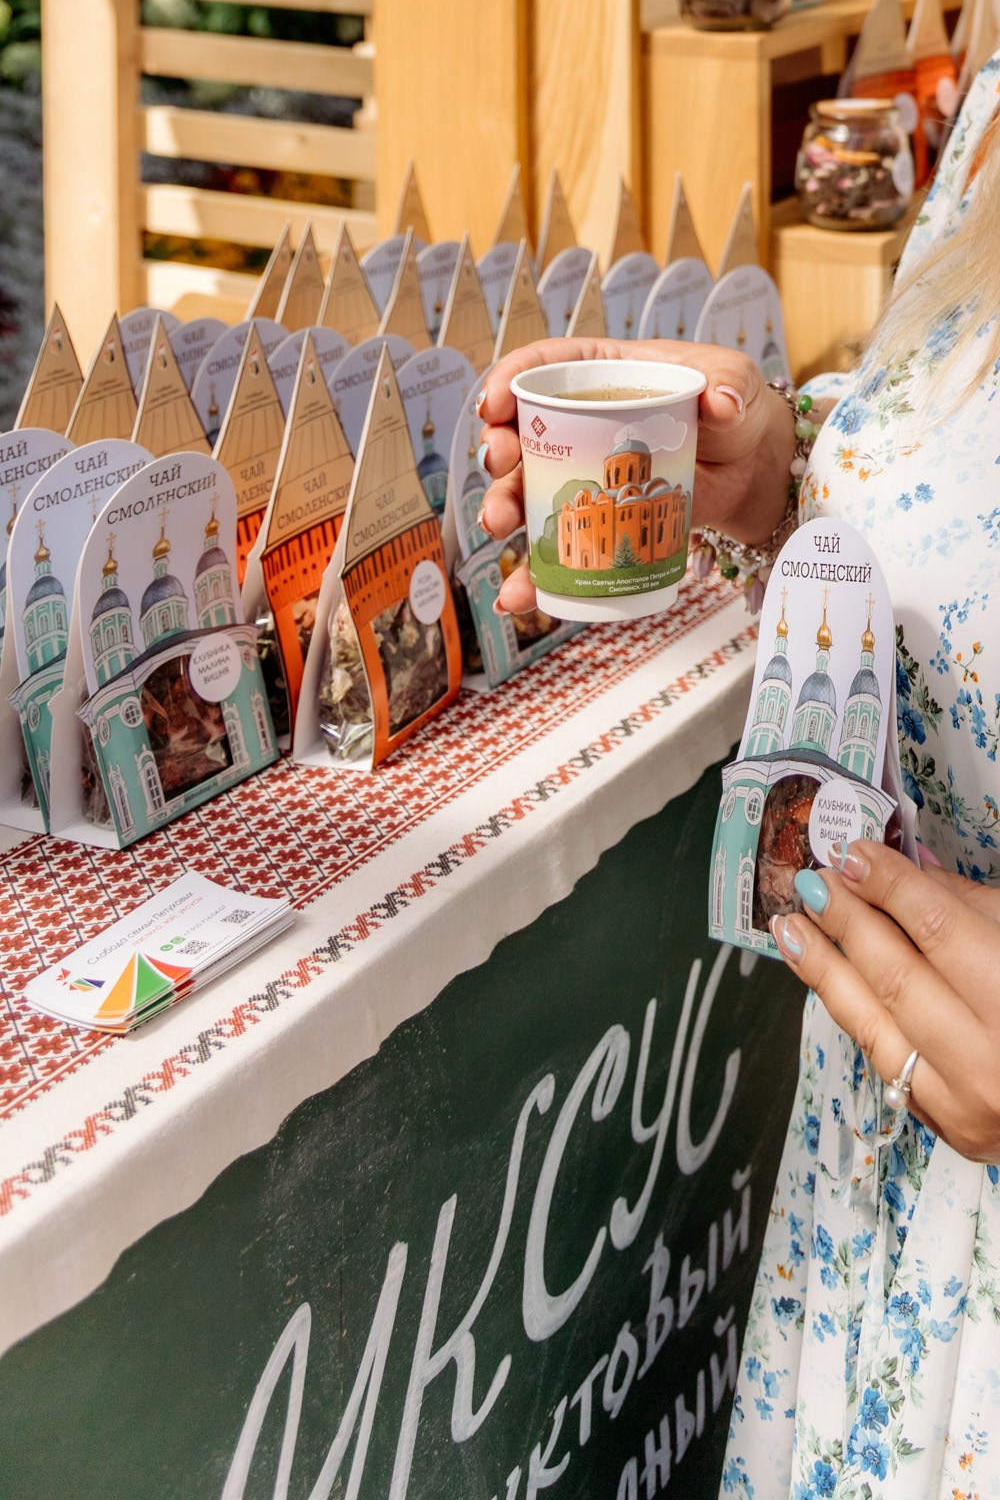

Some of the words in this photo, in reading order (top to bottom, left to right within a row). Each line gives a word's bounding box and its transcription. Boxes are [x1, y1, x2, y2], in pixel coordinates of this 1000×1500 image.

[74, 450, 109, 475] ЧАЙ
[240, 459, 266, 481] ЧАЙ
[149, 463, 182, 487] ЧАЙ
[303, 472, 328, 494] ЧАЙ
[106, 472, 217, 525] СМОЛЕНСКИЙ
[813, 532, 841, 554] ЧАЙ
[781, 560, 873, 583] СМОЛЕНСКИЙ
[192, 642, 231, 666] КЛУБНИКА
[817, 797, 857, 814] КЛУБНИКА
[818, 813, 852, 828] МАЛИНА
[819, 828, 848, 841] ВИШНЯ
[86, 937, 129, 965] Слобода
[127, 918, 155, 940] семьи
[152, 891, 194, 921] Петуховых
